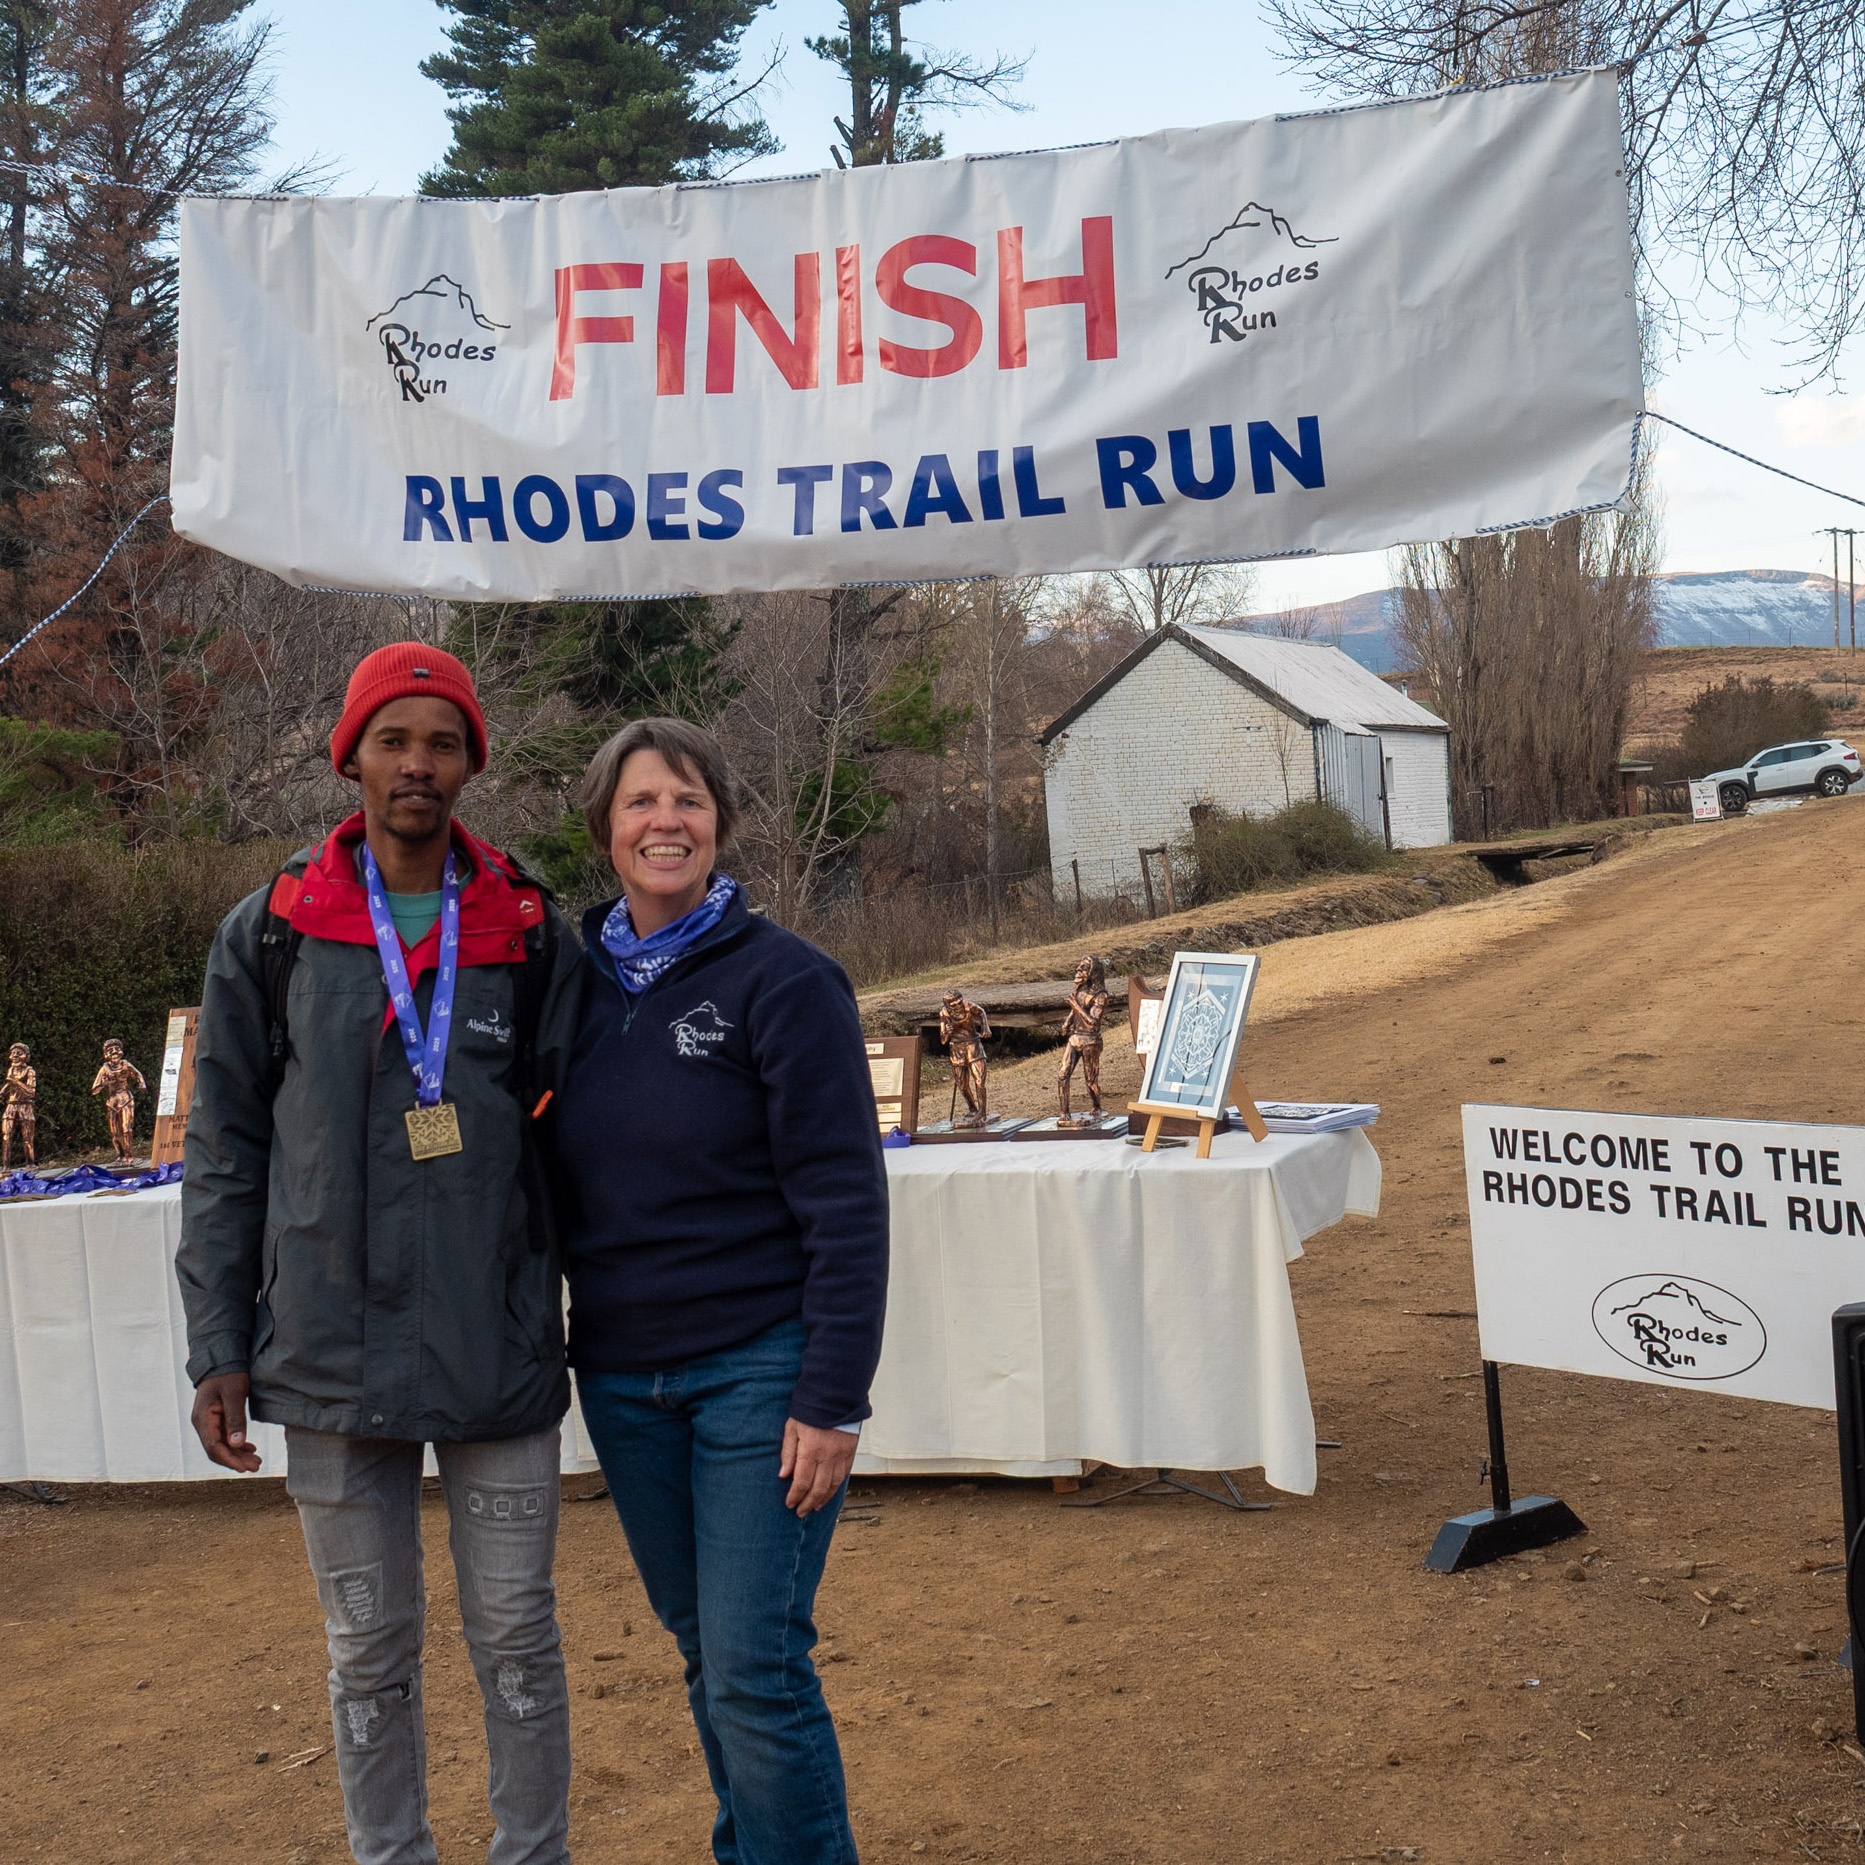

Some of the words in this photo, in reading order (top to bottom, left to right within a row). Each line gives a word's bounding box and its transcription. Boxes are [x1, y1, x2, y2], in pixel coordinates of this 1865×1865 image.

[1188, 261, 1319, 311] Rhodes
[550, 216, 1118, 400] FINISH
[1203, 300, 1277, 344] Run
[379, 323, 496, 364] Rhodes
[394, 360, 447, 403] Run
[403, 469, 744, 543] RHODES
[777, 445, 1067, 536] TRAIL
[1096, 415, 1326, 509] RUN
[466, 1018, 493, 1034] Alpine
[675, 1023, 725, 1042] Rhodes
[677, 1039, 709, 1057] Run
[1489, 1127, 1672, 1172] WELCOME
[1690, 1141, 1743, 1178] TO
[1764, 1146, 1842, 1186] THE
[1482, 1170, 1631, 1215] RHODES
[1650, 1184, 1767, 1228] TRAIL
[1787, 1195, 1865, 1238] RUN
[1627, 1313, 1728, 1346] Rhodes
[1640, 1338, 1696, 1368] Run
